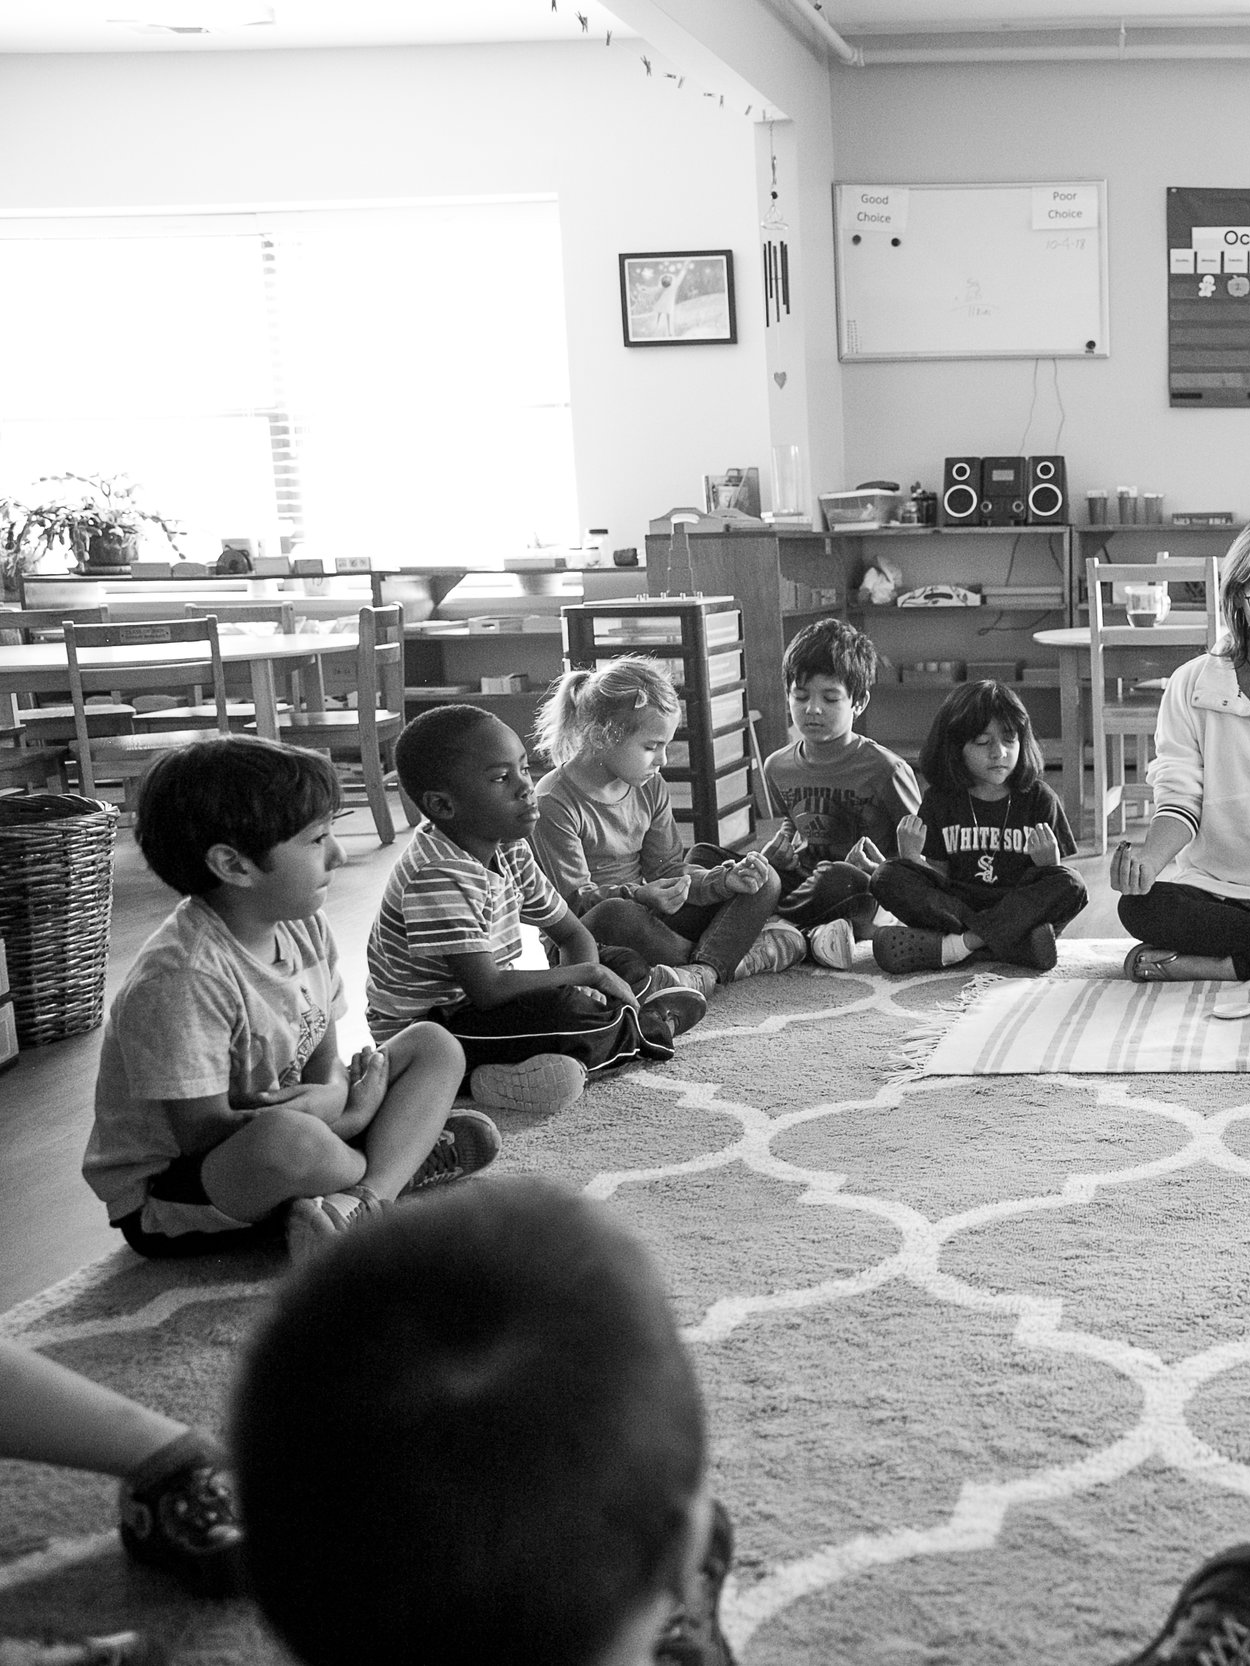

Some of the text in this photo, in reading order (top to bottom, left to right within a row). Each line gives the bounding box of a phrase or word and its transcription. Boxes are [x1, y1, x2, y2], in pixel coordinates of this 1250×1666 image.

[861, 194, 889, 205] Good
[1052, 191, 1077, 201] Poor
[857, 211, 891, 223] Choice
[1048, 208, 1083, 219] Choice
[942, 824, 1000, 854] WHITE
